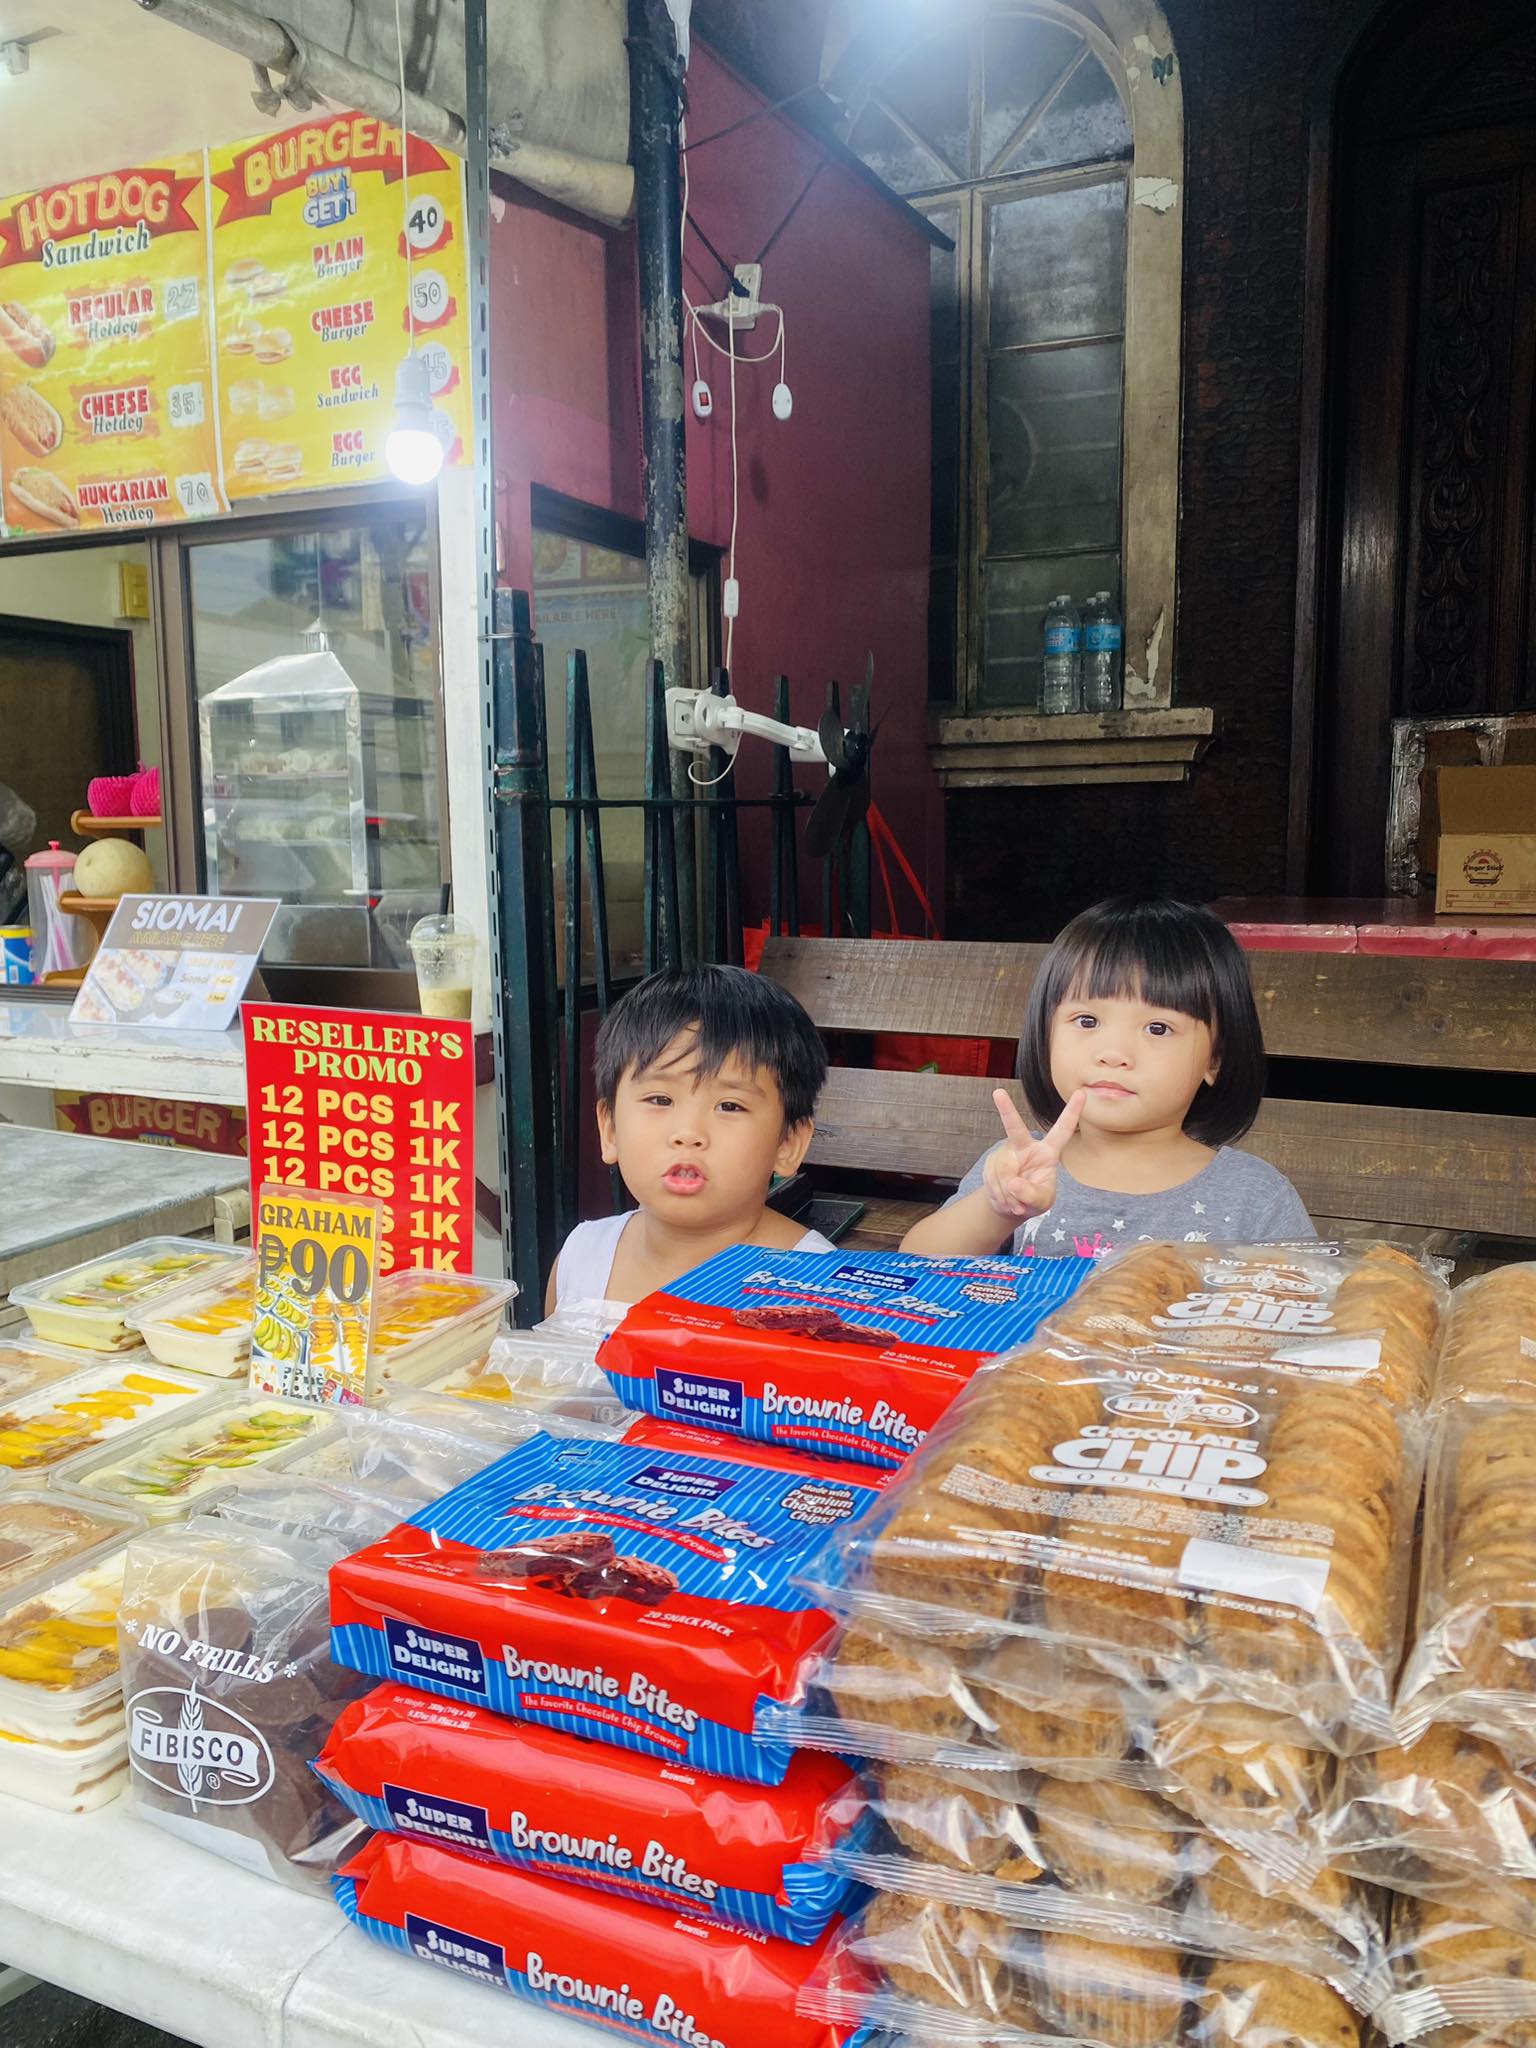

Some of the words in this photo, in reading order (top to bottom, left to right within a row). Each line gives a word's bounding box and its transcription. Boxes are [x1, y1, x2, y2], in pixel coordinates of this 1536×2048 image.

[243, 116, 403, 199] BURGER
[305, 170, 344, 198] BUY
[18, 174, 171, 250] HOTDOG
[303, 197, 347, 225] GET
[345, 189, 357, 216] 1
[42, 221, 150, 269] Sandwich
[312, 236, 364, 264] PLAIN
[408, 206, 438, 234] 40
[317, 258, 363, 278] Burger
[69, 288, 154, 326] REGULAR
[311, 300, 374, 332] CHEESE
[413, 281, 441, 309] 50
[88, 318, 139, 340] Hotdog
[321, 324, 368, 343] Burger
[330, 364, 362, 390] EGG
[81, 388, 149, 420] CHEESE
[170, 391, 196, 418] 35
[316, 382, 379, 408] Sandwich
[93, 415, 144, 434] Hotdog
[332, 429, 363, 454] EGG
[331, 450, 376, 468] Burger
[77, 477, 169, 507] HUNGARIAN
[180, 480, 210, 506] 70
[102, 504, 155, 524] Hotdog
[131, 900, 244, 934] SIOMAI
[251, 1016, 464, 1060] RESELLER'S
[293, 1049, 423, 1086] PROMO
[88, 1096, 222, 1145] BURGER
[260, 1084, 305, 1116] 12
[317, 1088, 395, 1125] PCS
[409, 1099, 462, 1133] 1K
[262, 1119, 306, 1152] 12
[318, 1125, 396, 1162] PCS
[409, 1135, 462, 1170] 1K
[263, 1155, 306, 1187] 12
[319, 1161, 396, 1198] PCS
[409, 1172, 462, 1207] 1K
[259, 1203, 372, 1240] GRAHAM
[409, 1209, 461, 1244] 1K
[409, 1246, 461, 1273] 1K
[1218, 1258, 1249, 1267] NO
[836, 1272, 907, 1292] DELIGHTS
[853, 1268, 907, 1286] SUPER
[962, 1284, 1018, 1297] Premium
[741, 1270, 880, 1301] Brownie
[883, 1295, 967, 1319] Bites
[1186, 1291, 1329, 1310] CHOCOLATE
[1166, 1297, 1336, 1331] CHIP
[928, 1359, 957, 1370] PACK
[673, 1377, 731, 1402] SUPER
[1122, 1370, 1162, 1384] NO
[1165, 1373, 1261, 1395] FRILLS
[662, 1389, 738, 1420] DELIGHTS
[761, 1381, 864, 1426] Brownie
[867, 1399, 930, 1449] Bites
[1127, 1401, 1233, 1417] FIBISCO
[775, 1425, 788, 1436] The
[821, 1429, 859, 1448] Chocolate
[860, 1437, 878, 1454] Chip
[1079, 1424, 1260, 1452] CHOCOLATE
[1052, 1437, 1268, 1485] CHIP
[635, 1475, 719, 1498] DELIGHTS
[657, 1470, 720, 1488] SUPER
[801, 1483, 827, 1496] Made
[827, 1487, 852, 1499] with
[1045, 1469, 1251, 1503] COOKIES
[513, 1482, 680, 1521] Brownie
[678, 1507, 776, 1549] Bites
[780, 1497, 852, 1518] Chocolate
[788, 1489, 854, 1509] Premium
[589, 1510, 647, 1531] Chocolate
[650, 1527, 676, 1542] Chip
[676, 1532, 726, 1560] Brownie
[789, 1511, 834, 1525] Chips!
[644, 1610, 663, 1619] 20
[661, 1613, 703, 1627] SNACK
[699, 1619, 735, 1637] PACK
[137, 1623, 182, 1656] NO
[180, 1639, 280, 1685] FRILLS
[405, 1628, 470, 1663] SUPER
[393, 1644, 480, 1685] DELIGHTS
[501, 1643, 621, 1699] Brownie
[626, 1671, 700, 1733] Bites
[523, 1695, 539, 1707] The
[575, 1702, 621, 1725] Chocolate
[620, 1713, 642, 1734] Chip
[642, 1723, 683, 1751] Brownie
[140, 1728, 244, 1764] FIBISCO
[394, 1811, 487, 1850] DELIGHTS
[406, 1797, 473, 1834] SUPER
[510, 1810, 633, 1870] Brownie
[640, 1839, 719, 1900] Bites
[673, 1919, 710, 1939] Brownies
[414, 1943, 506, 1987] DELIGHTS
[425, 1928, 491, 1970] SUPER
[525, 1951, 645, 2021] Brownie
